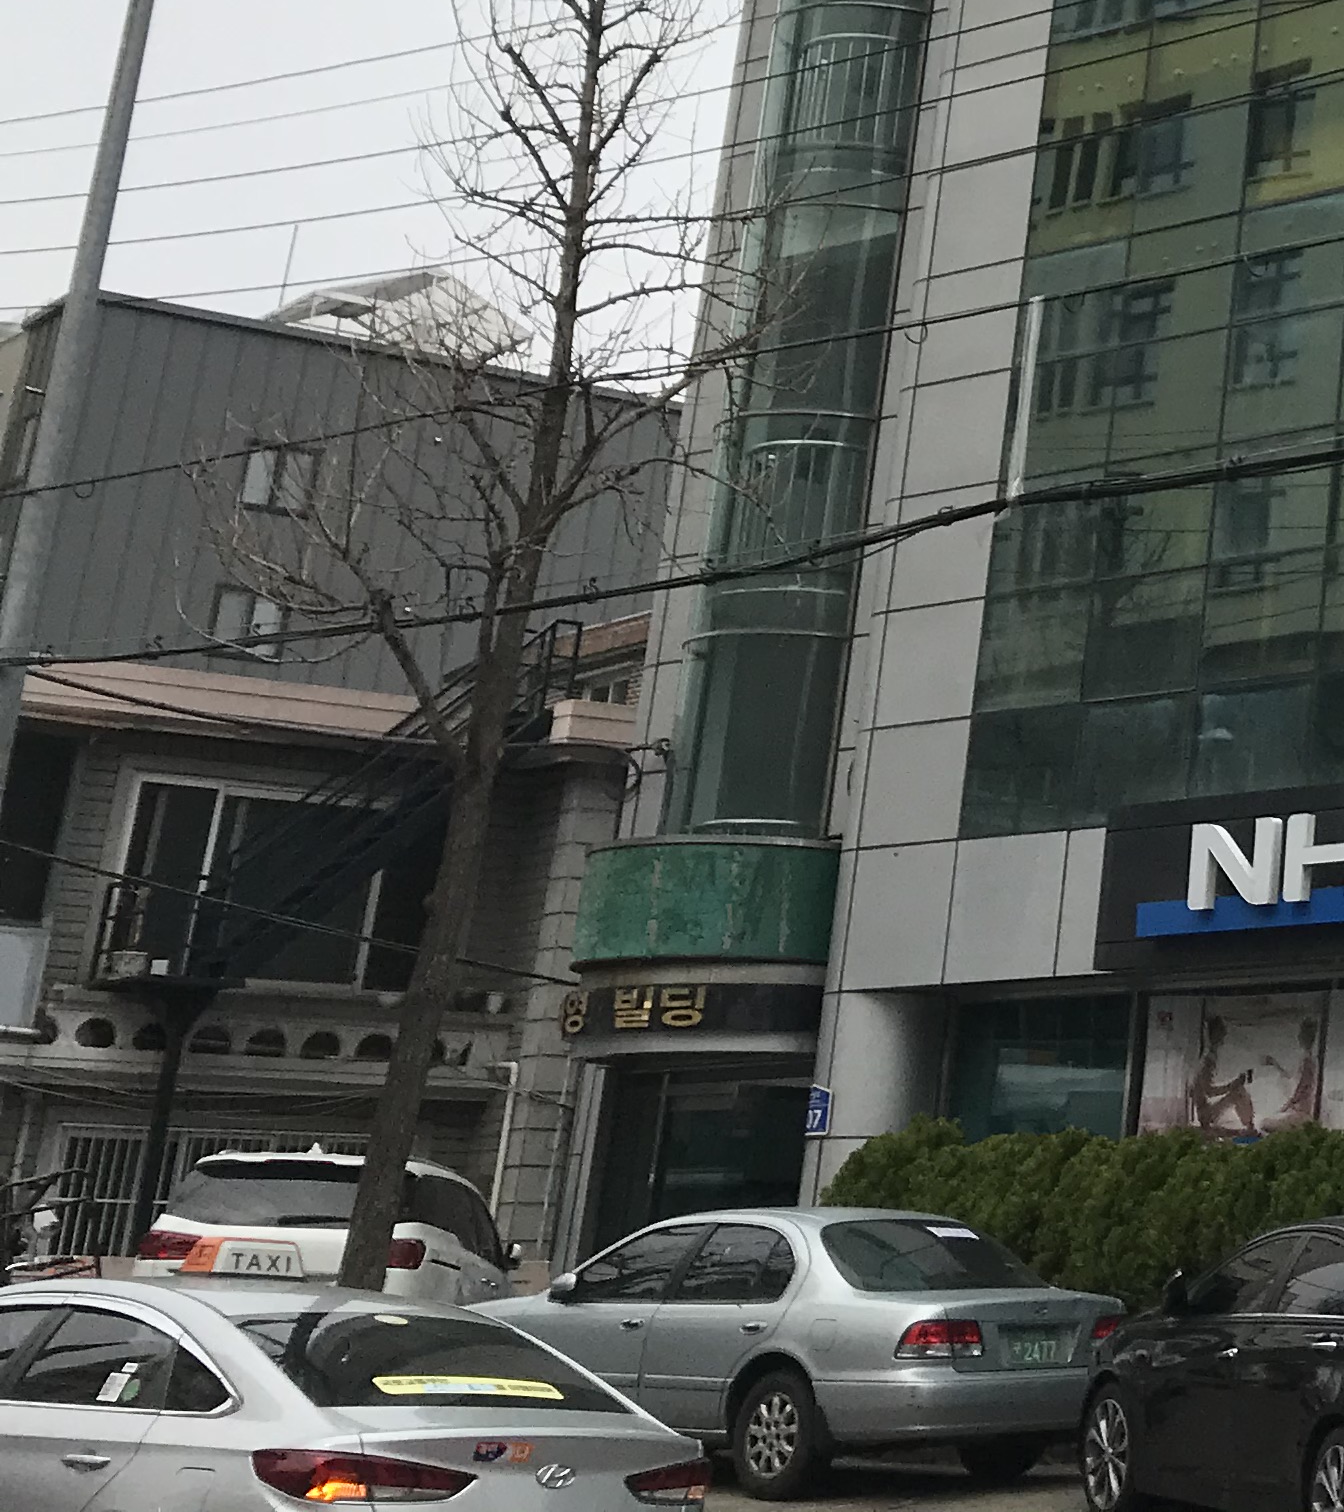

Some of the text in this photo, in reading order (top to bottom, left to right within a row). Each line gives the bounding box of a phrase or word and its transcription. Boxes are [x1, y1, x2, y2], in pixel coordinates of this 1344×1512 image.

[613, 987, 707, 1028] 빌딩
[231, 1252, 292, 1273] TAXI
[1024, 1340, 1056, 1364] 2477
